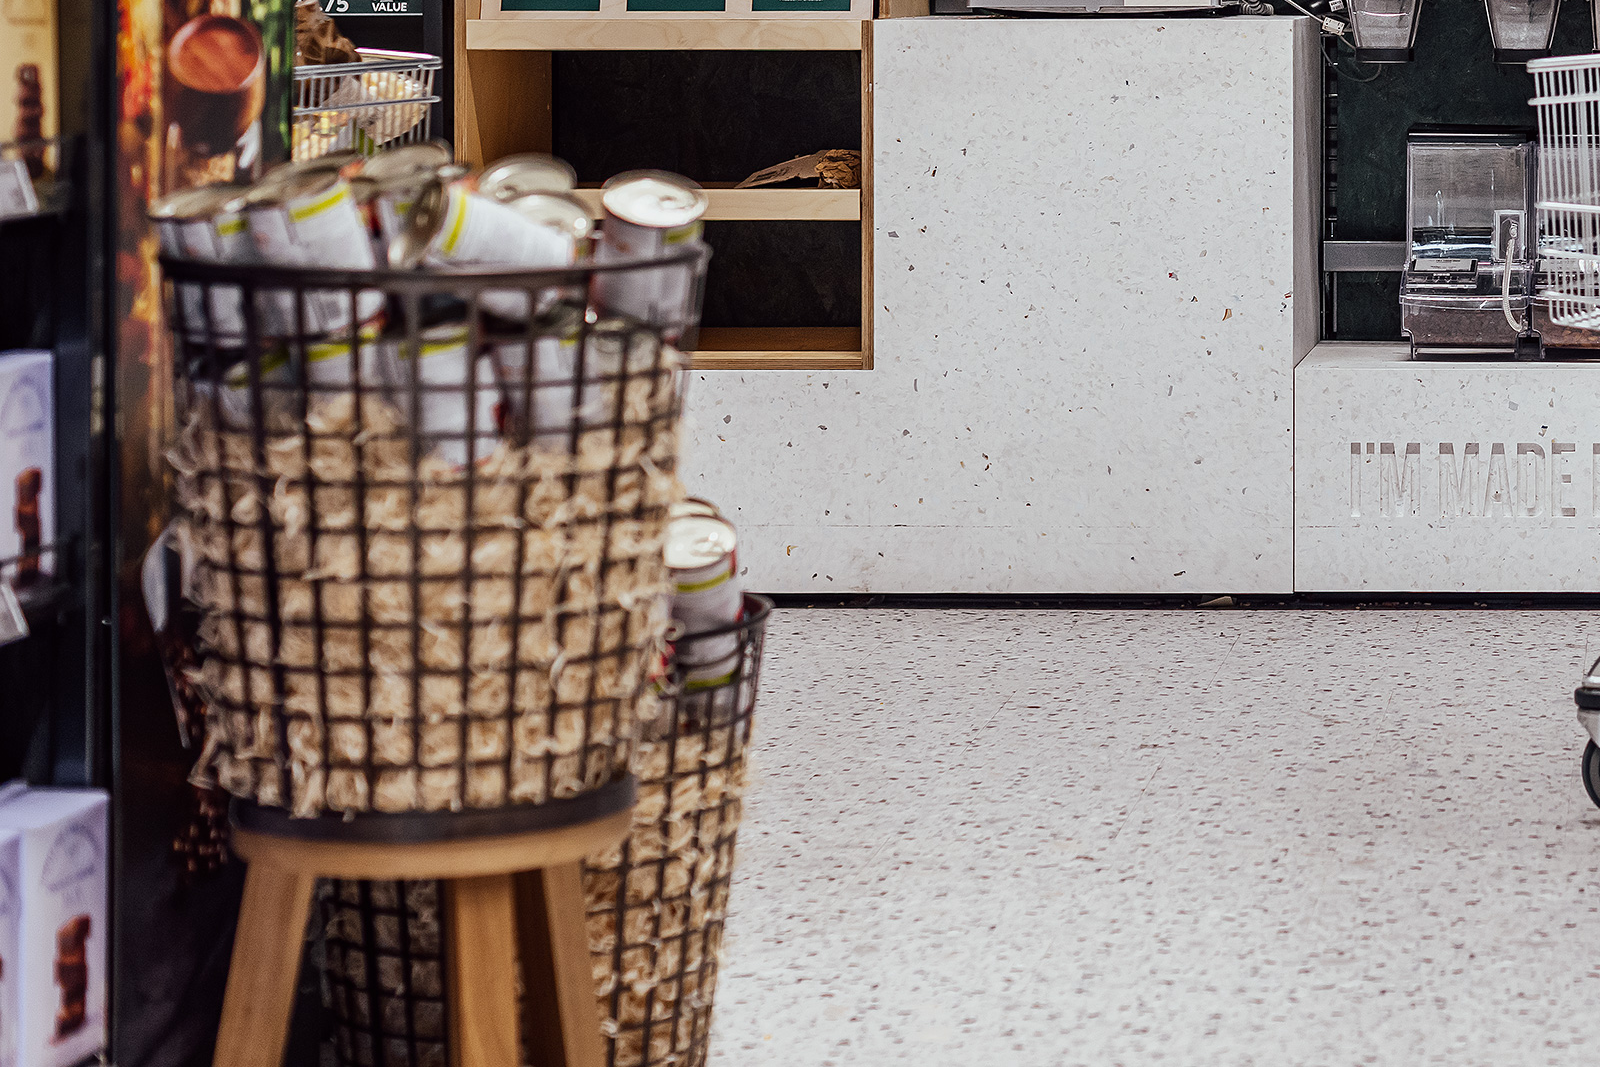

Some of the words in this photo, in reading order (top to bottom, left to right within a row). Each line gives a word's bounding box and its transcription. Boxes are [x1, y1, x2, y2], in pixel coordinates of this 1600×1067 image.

[371, 2, 408, 12] VALUE
[1349, 442, 1422, 519] I'M
[1438, 442, 1576, 519] MADE
